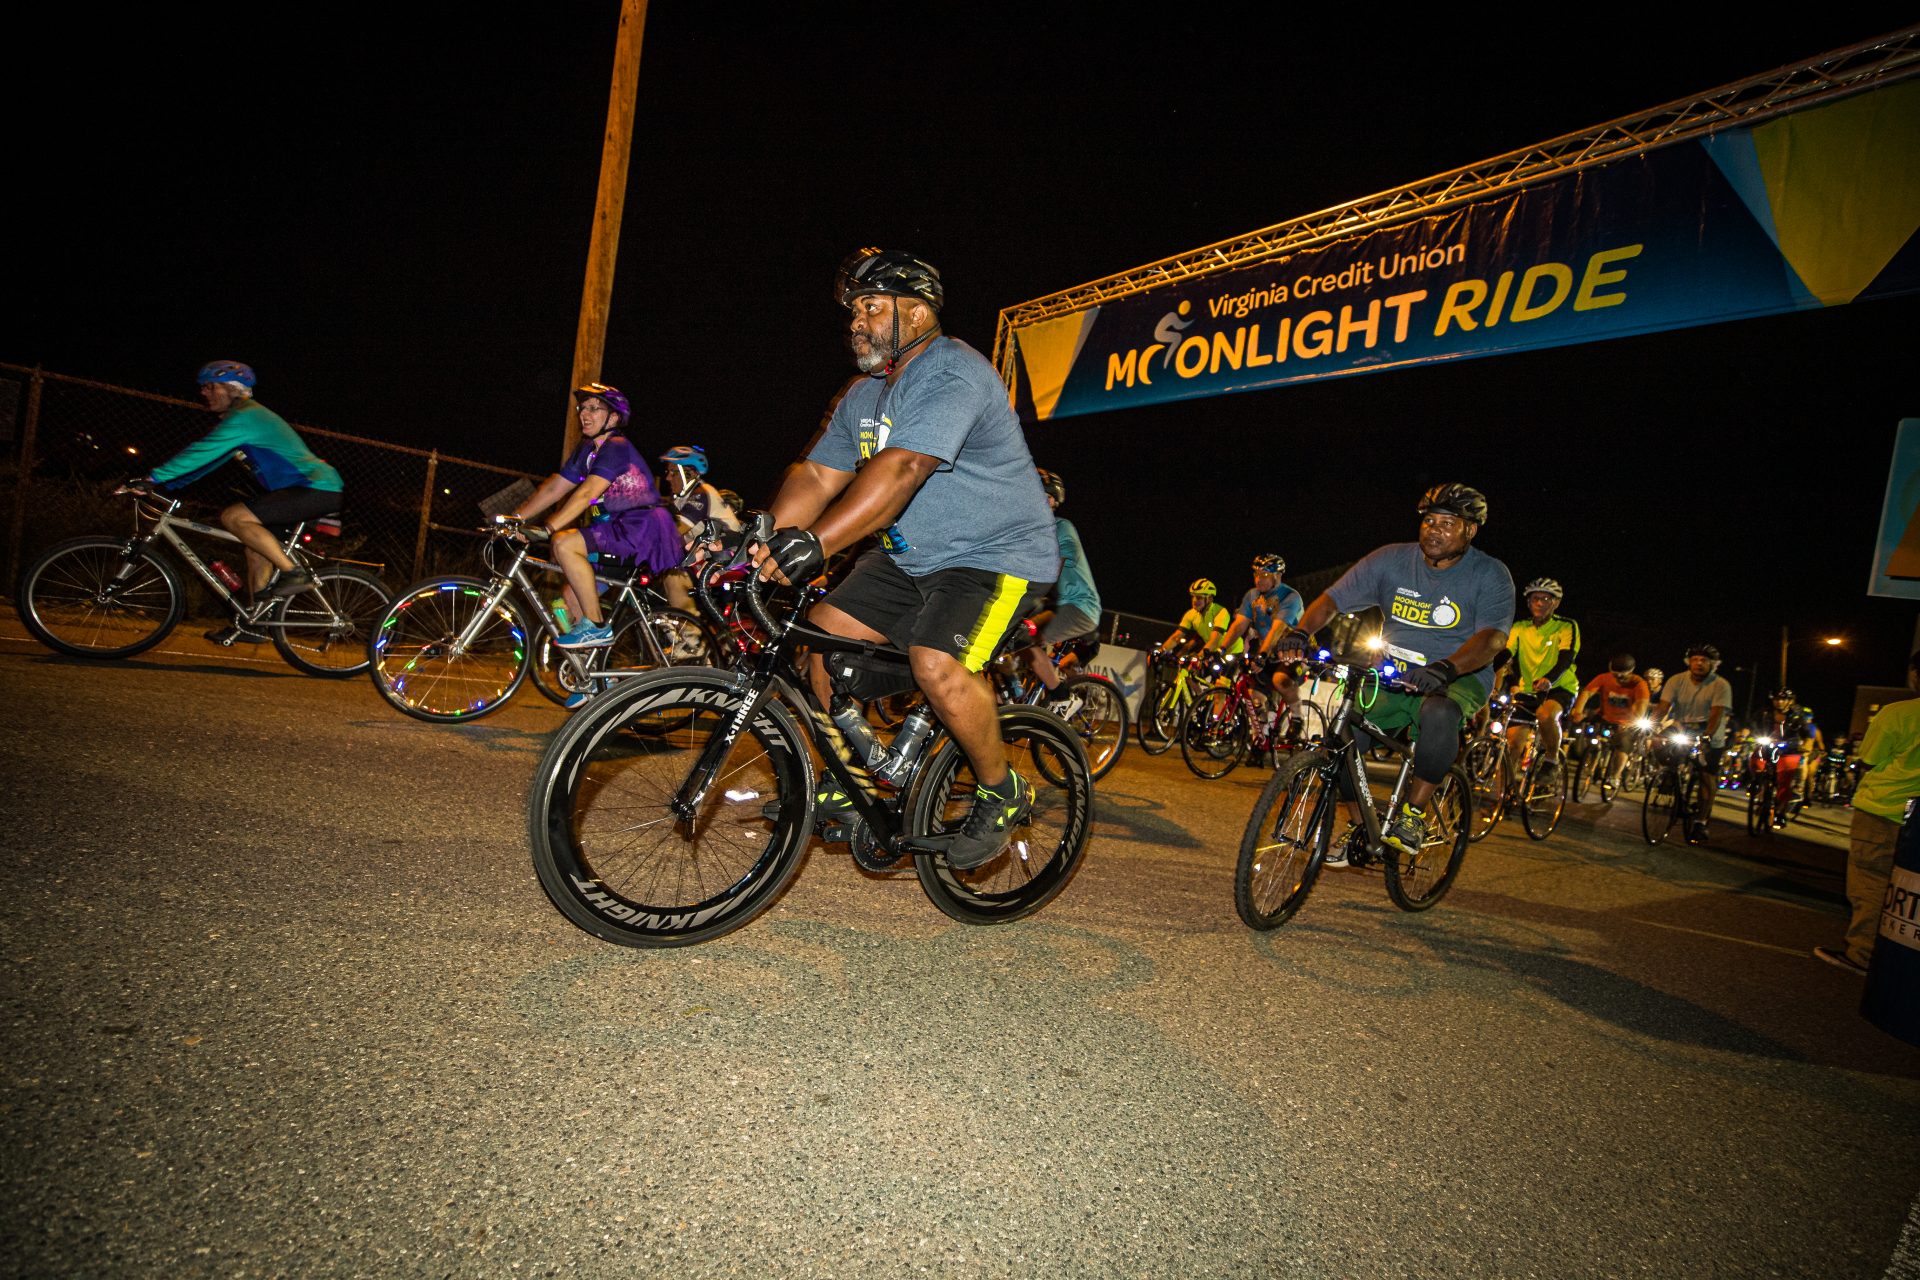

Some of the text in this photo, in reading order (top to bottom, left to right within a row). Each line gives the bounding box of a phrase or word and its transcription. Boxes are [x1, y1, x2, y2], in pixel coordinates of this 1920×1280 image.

[1208, 243, 1466, 318] Virginia Credit Union
[1433, 243, 1644, 338] RIDE
[1391, 602, 1431, 625] RIDE
[1394, 595, 1433, 610] MOONLIGHT
[724, 688, 759, 745] X-THREE
[569, 873, 697, 930] KNIGHT
